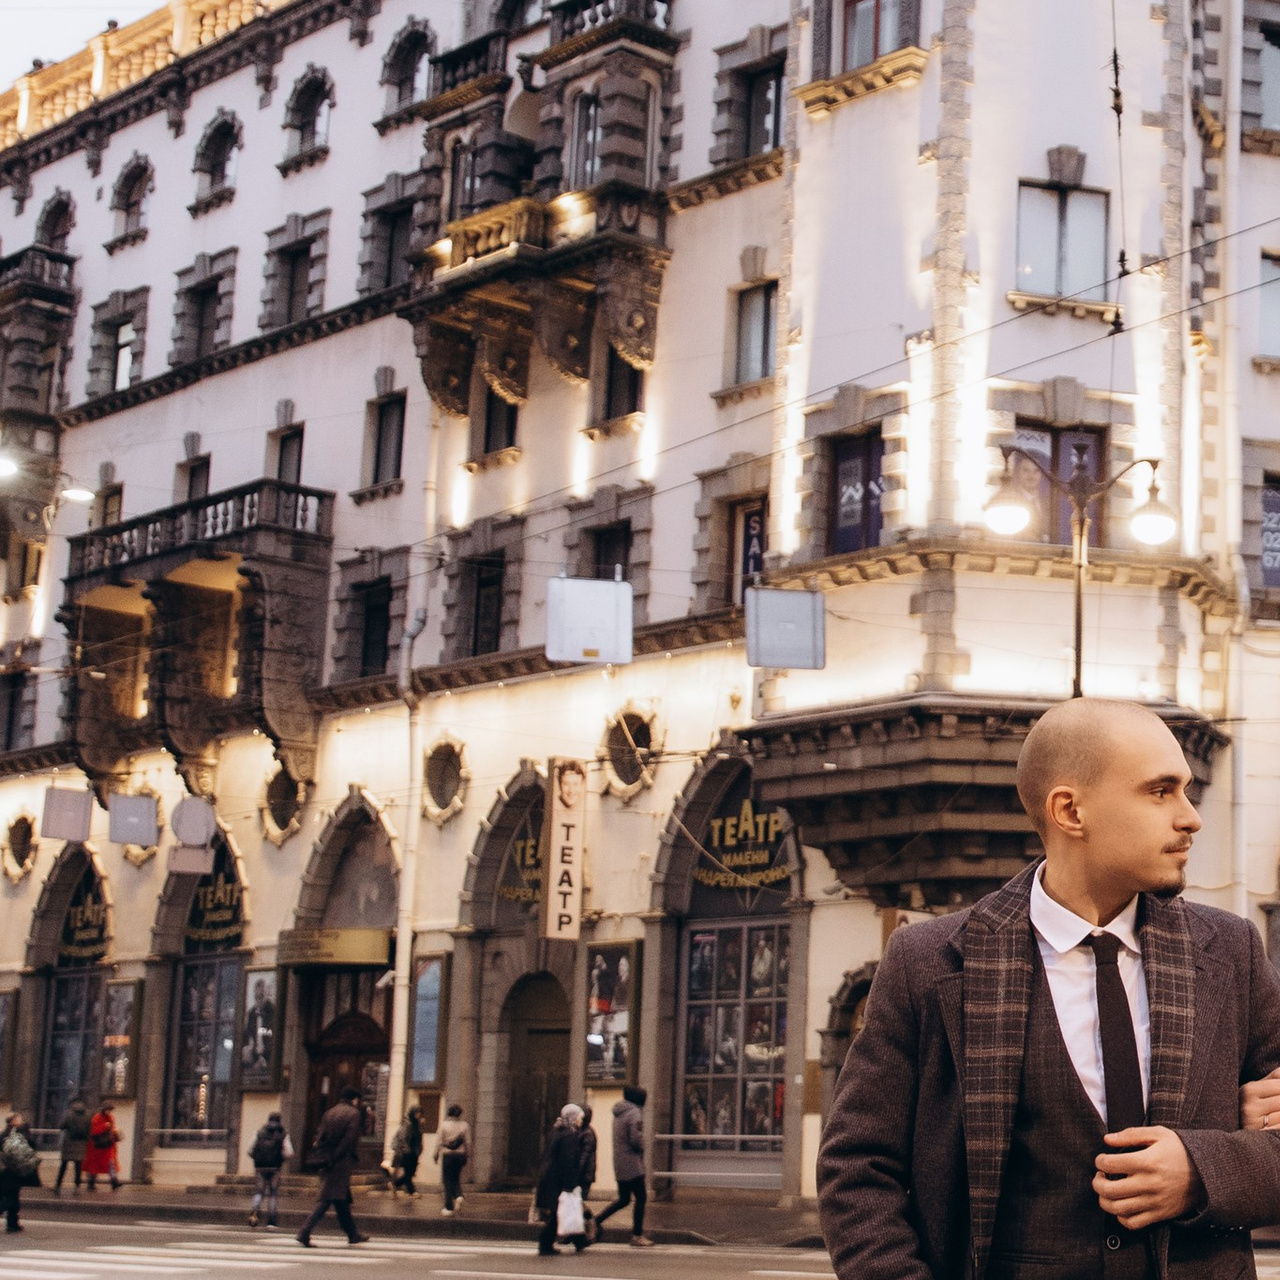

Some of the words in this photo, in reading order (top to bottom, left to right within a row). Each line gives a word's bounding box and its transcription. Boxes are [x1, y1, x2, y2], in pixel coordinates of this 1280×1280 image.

[749, 516, 761, 576] SAL
[710, 799, 783, 847] ТЕАТР
[558, 823, 575, 931] ТЕАТР
[722, 849, 768, 867] ИМЕНИ
